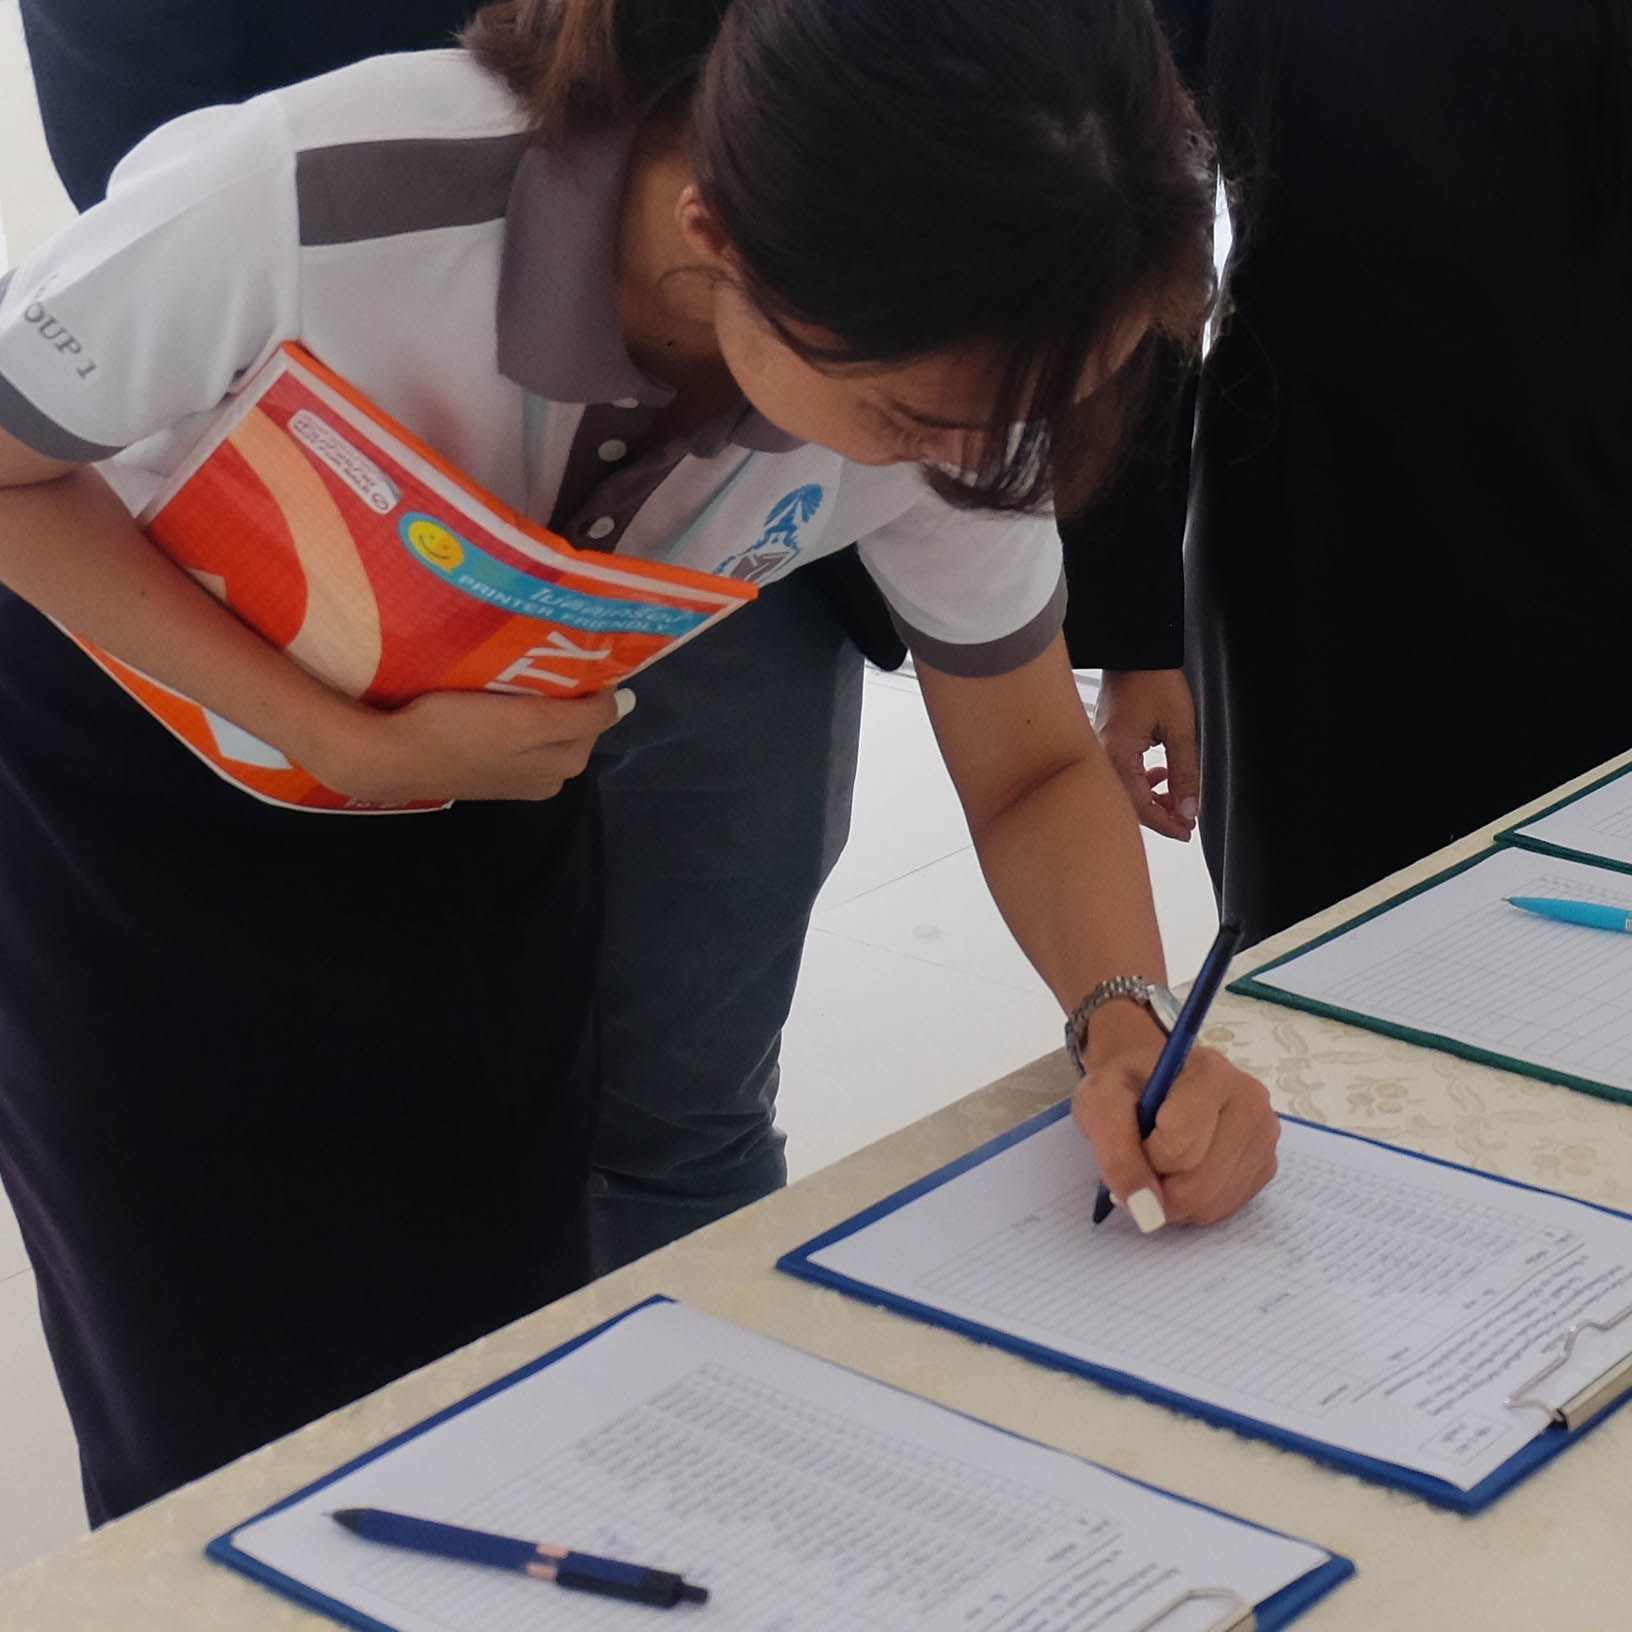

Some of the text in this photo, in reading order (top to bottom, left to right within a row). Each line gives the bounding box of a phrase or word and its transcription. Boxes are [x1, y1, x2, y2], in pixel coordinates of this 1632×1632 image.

[24, 290, 97, 380] OUP 1
[457, 574, 556, 617] PRINTER
